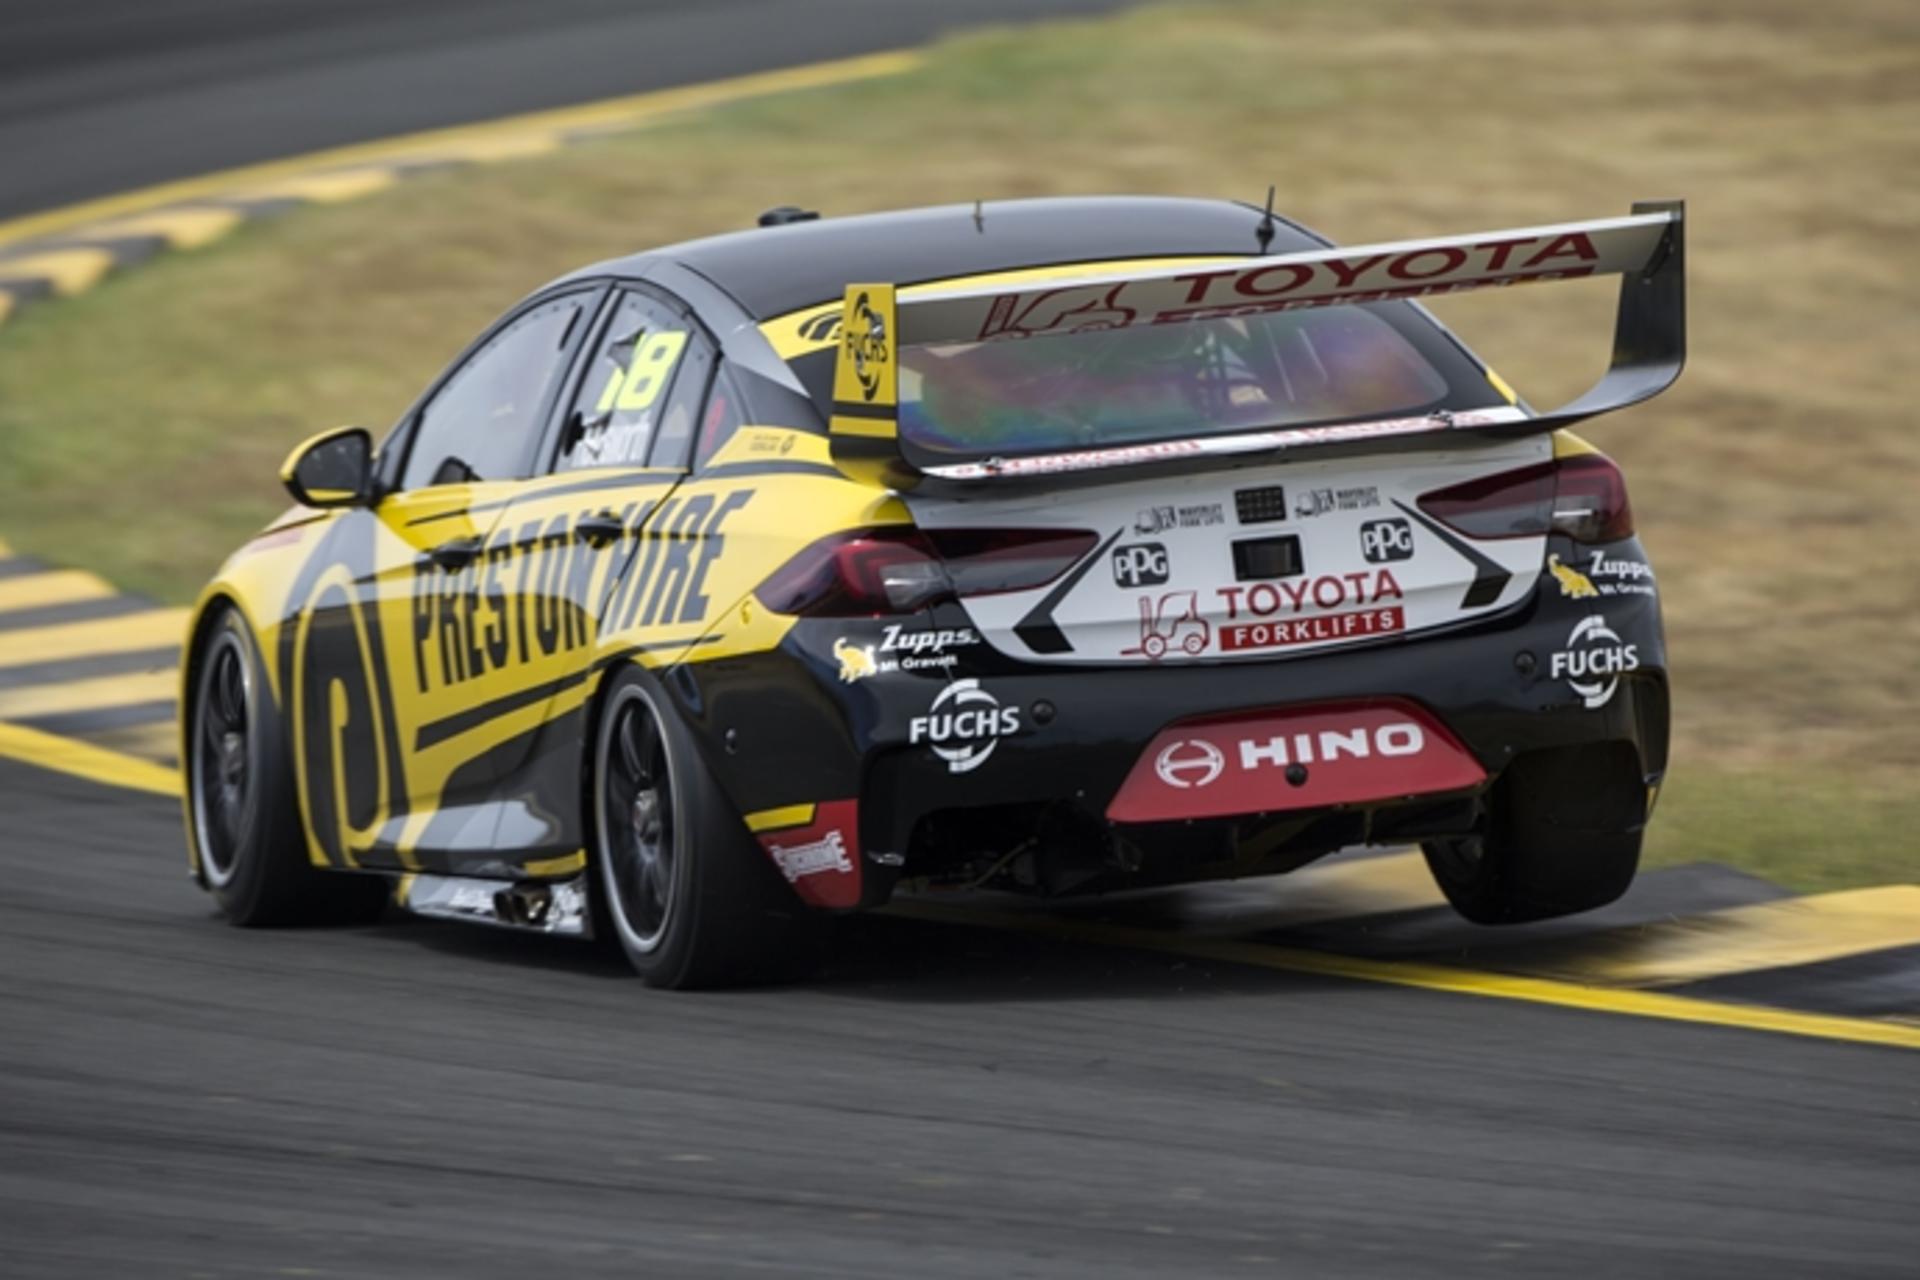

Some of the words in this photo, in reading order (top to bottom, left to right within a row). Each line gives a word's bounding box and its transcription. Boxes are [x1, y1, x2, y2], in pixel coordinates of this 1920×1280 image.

[1174, 232, 1598, 303] TOYOTA
[596, 331, 687, 412] 18
[1363, 522, 1412, 560] PPG
[1115, 548, 1167, 584] PPG
[413, 506, 602, 693] PRESTON
[600, 489, 755, 635] HIRE
[1216, 568, 1404, 618] TOYOTA
[1234, 611, 1396, 646] FORKLIFTS
[1552, 644, 1639, 679] FUCHS
[909, 705, 1021, 744] FUCHS
[1238, 722, 1424, 770] HINO
